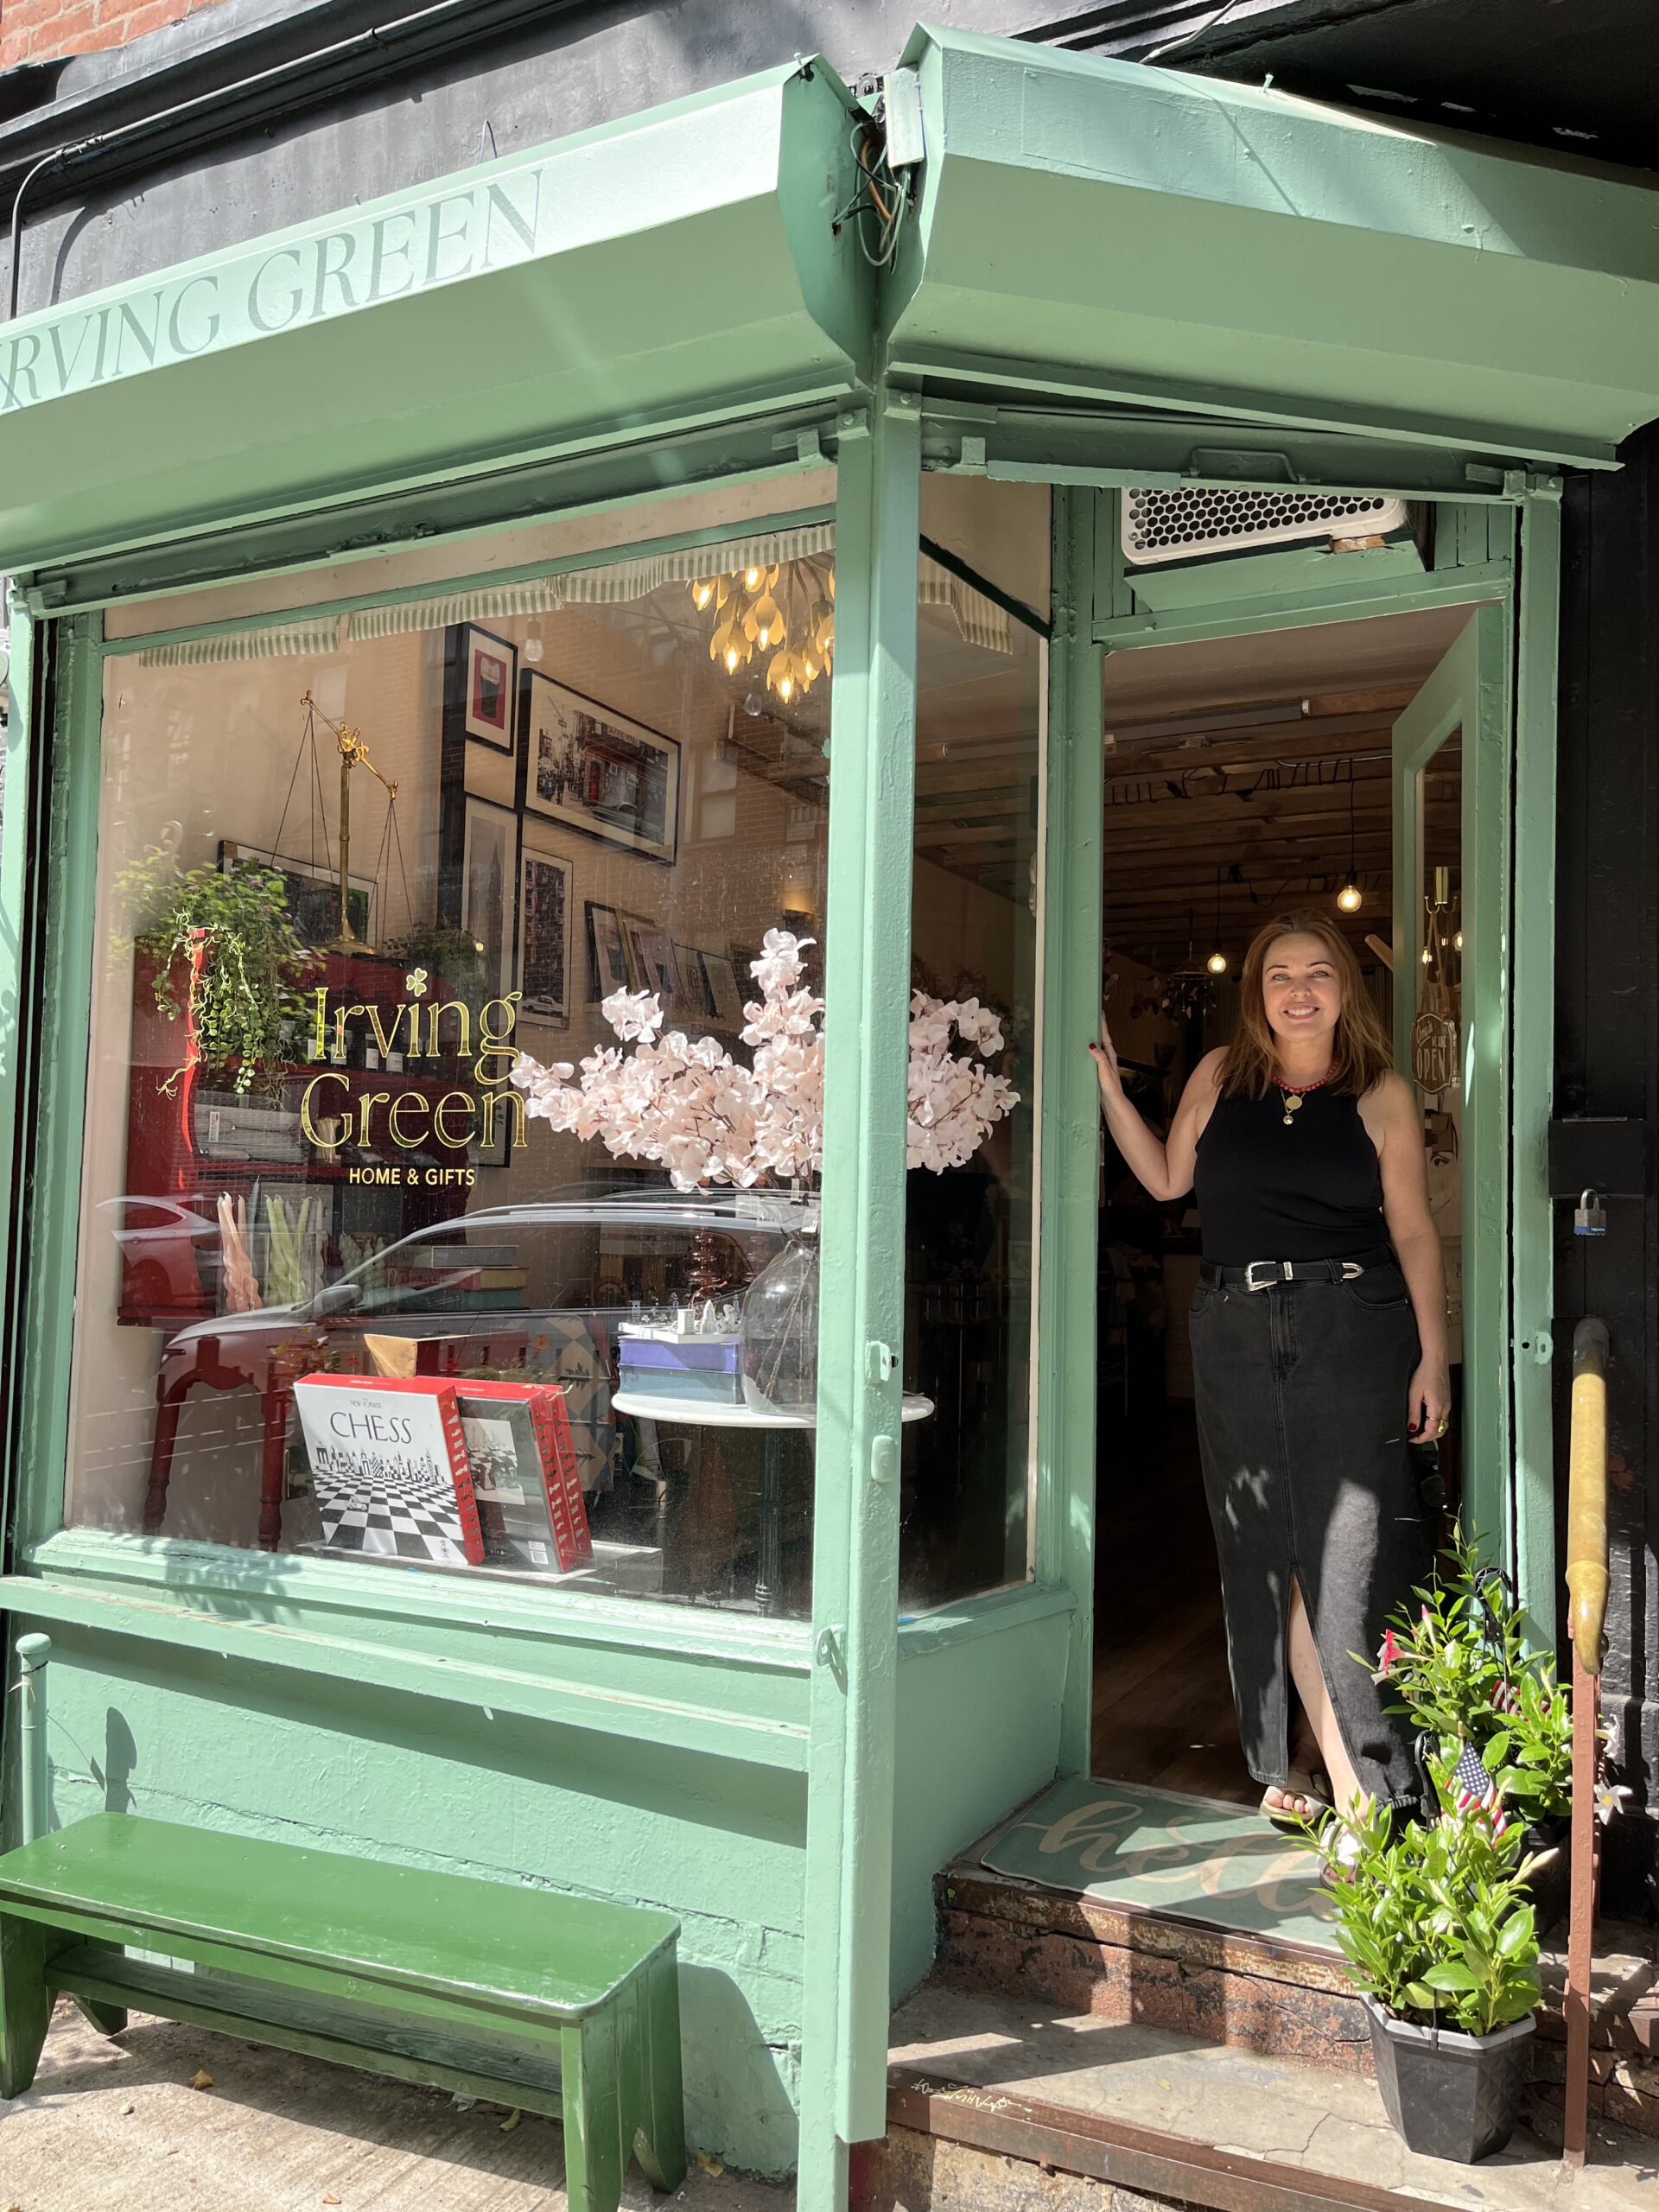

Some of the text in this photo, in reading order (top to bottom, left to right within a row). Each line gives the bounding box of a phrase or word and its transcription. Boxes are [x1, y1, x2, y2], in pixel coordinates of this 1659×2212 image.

[0, 169, 543, 410] RVING GREEN
[314, 968, 523, 1085] Irving
[1417, 1047, 1446, 1082] OPEN
[301, 1073, 528, 1148] Green
[349, 1167, 476, 1186] HOME & GIFTS
[330, 1411, 412, 1445] CHESS
